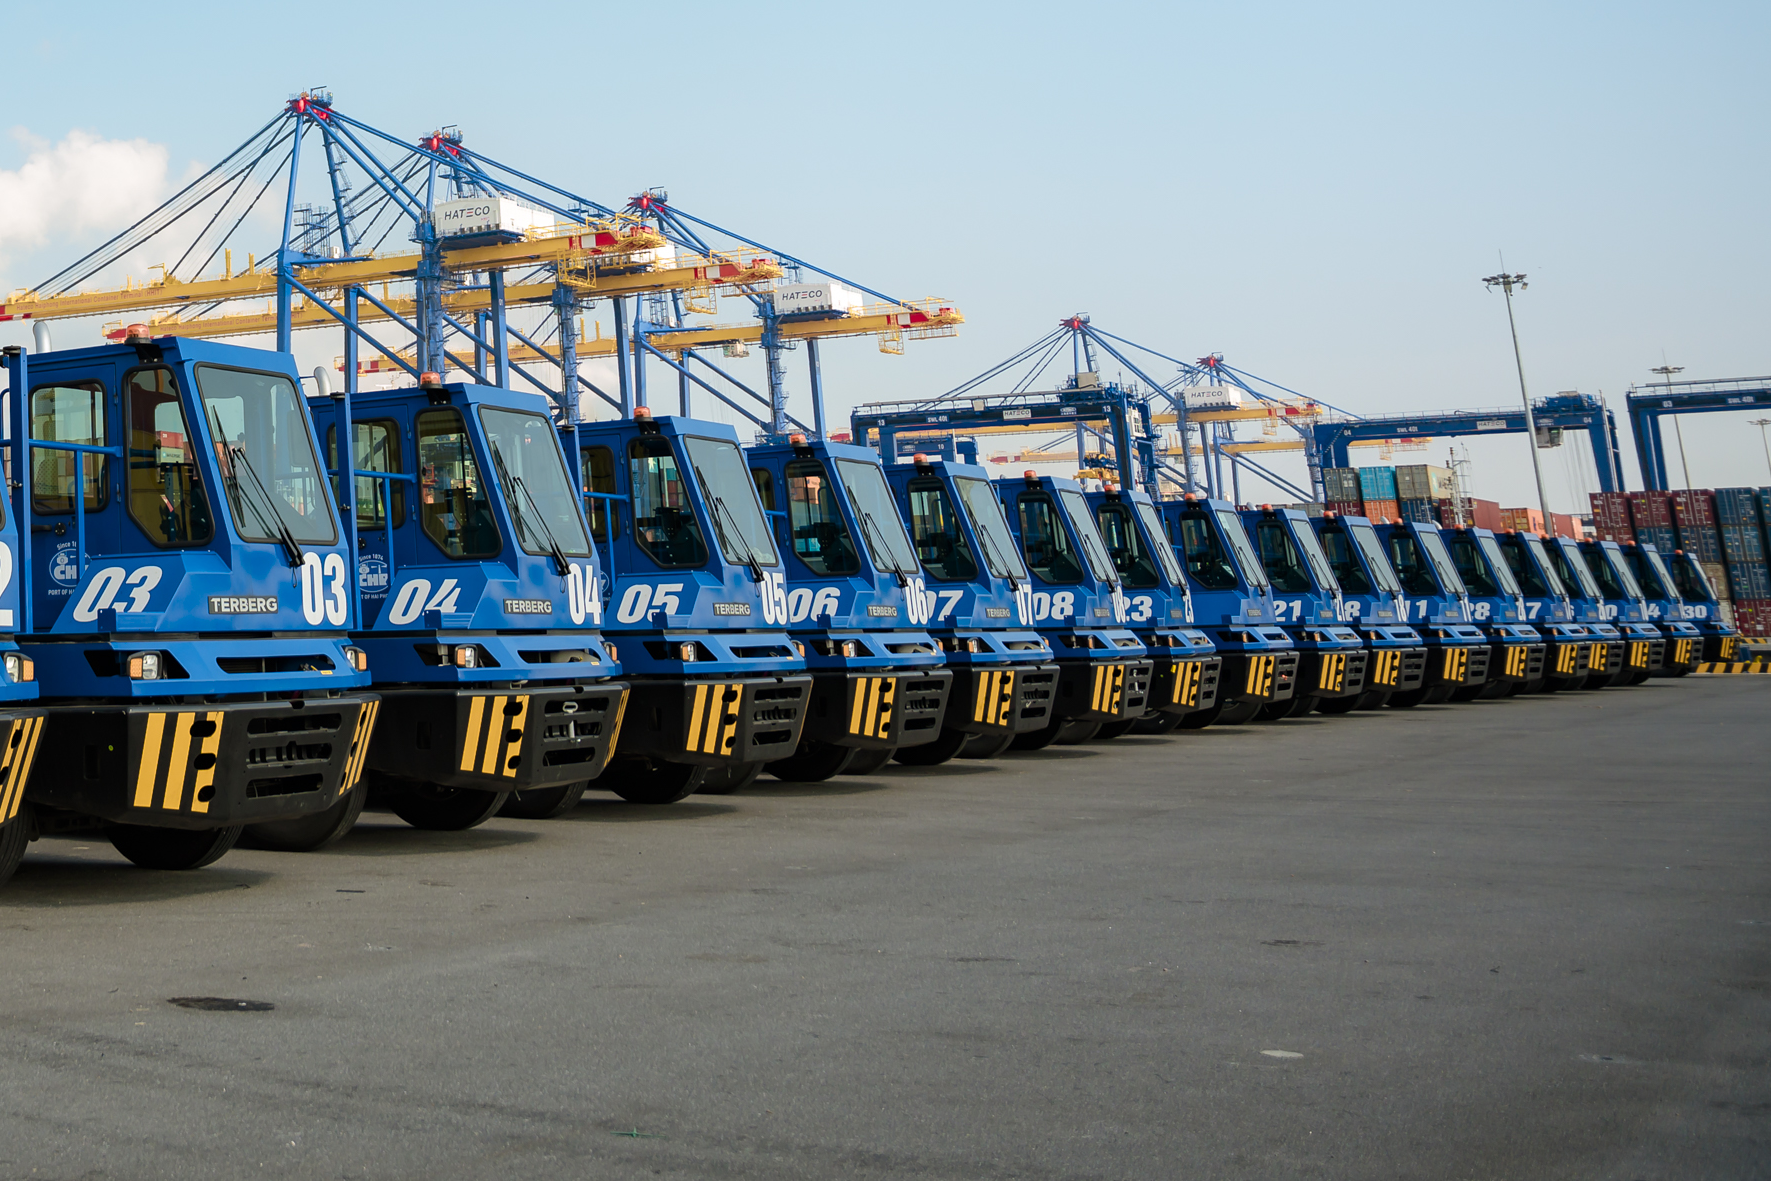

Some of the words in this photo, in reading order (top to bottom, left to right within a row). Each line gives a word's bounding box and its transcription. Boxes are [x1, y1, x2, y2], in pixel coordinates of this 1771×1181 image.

[444, 205, 490, 220] HATECO
[35, 301, 59, 310] Haiphong
[60, 297, 92, 306] International
[93, 294, 119, 303] Container
[120, 291, 143, 300] Terminal
[782, 290, 823, 301] HATECO
[203, 318, 234, 328] International
[235, 316, 261, 326] Container
[1004, 409, 1030, 417] HATECO
[1102, 405, 1111, 413] 13
[877, 419, 885, 427] 13
[73, 565, 163, 622] 03
[301, 551, 348, 626] 03
[568, 563, 601, 625] 04
[761, 571, 789, 626] 05
[210, 597, 278, 613] TERBERG
[389, 578, 461, 625] 04
[506, 600, 552, 614] TERBERG
[617, 583, 684, 624] 05
[714, 604, 751, 616] TERBERG
[788, 587, 841, 623] 06
[868, 606, 897, 616] TERBERG
[906, 577, 928, 625] 06
[1016, 584, 1033, 626] 07
[1033, 591, 1075, 620] 08
[1273, 600, 1302, 622] 21
